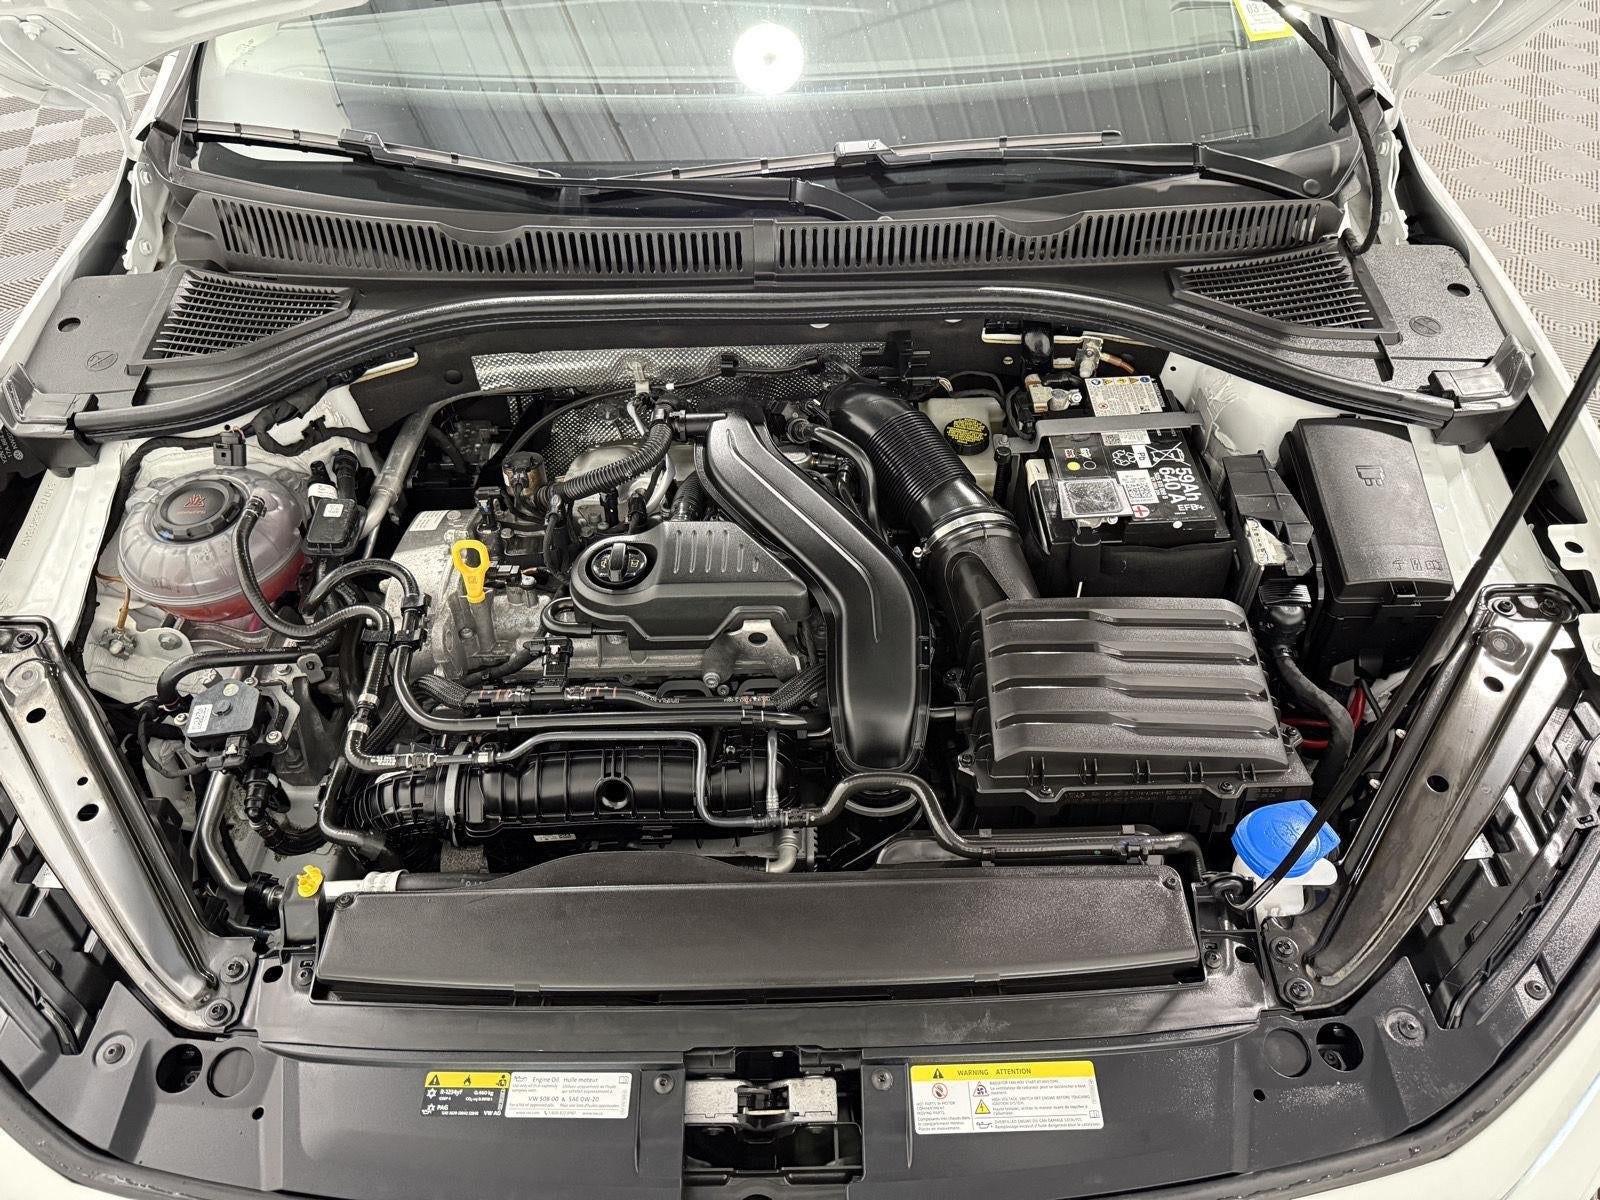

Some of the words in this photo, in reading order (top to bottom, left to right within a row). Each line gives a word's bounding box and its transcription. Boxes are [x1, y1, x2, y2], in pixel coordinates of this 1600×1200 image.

[1159, 467, 1181, 490] 640
[1175, 467, 1202, 501] 59Ah
[1168, 493, 1186, 504] A
